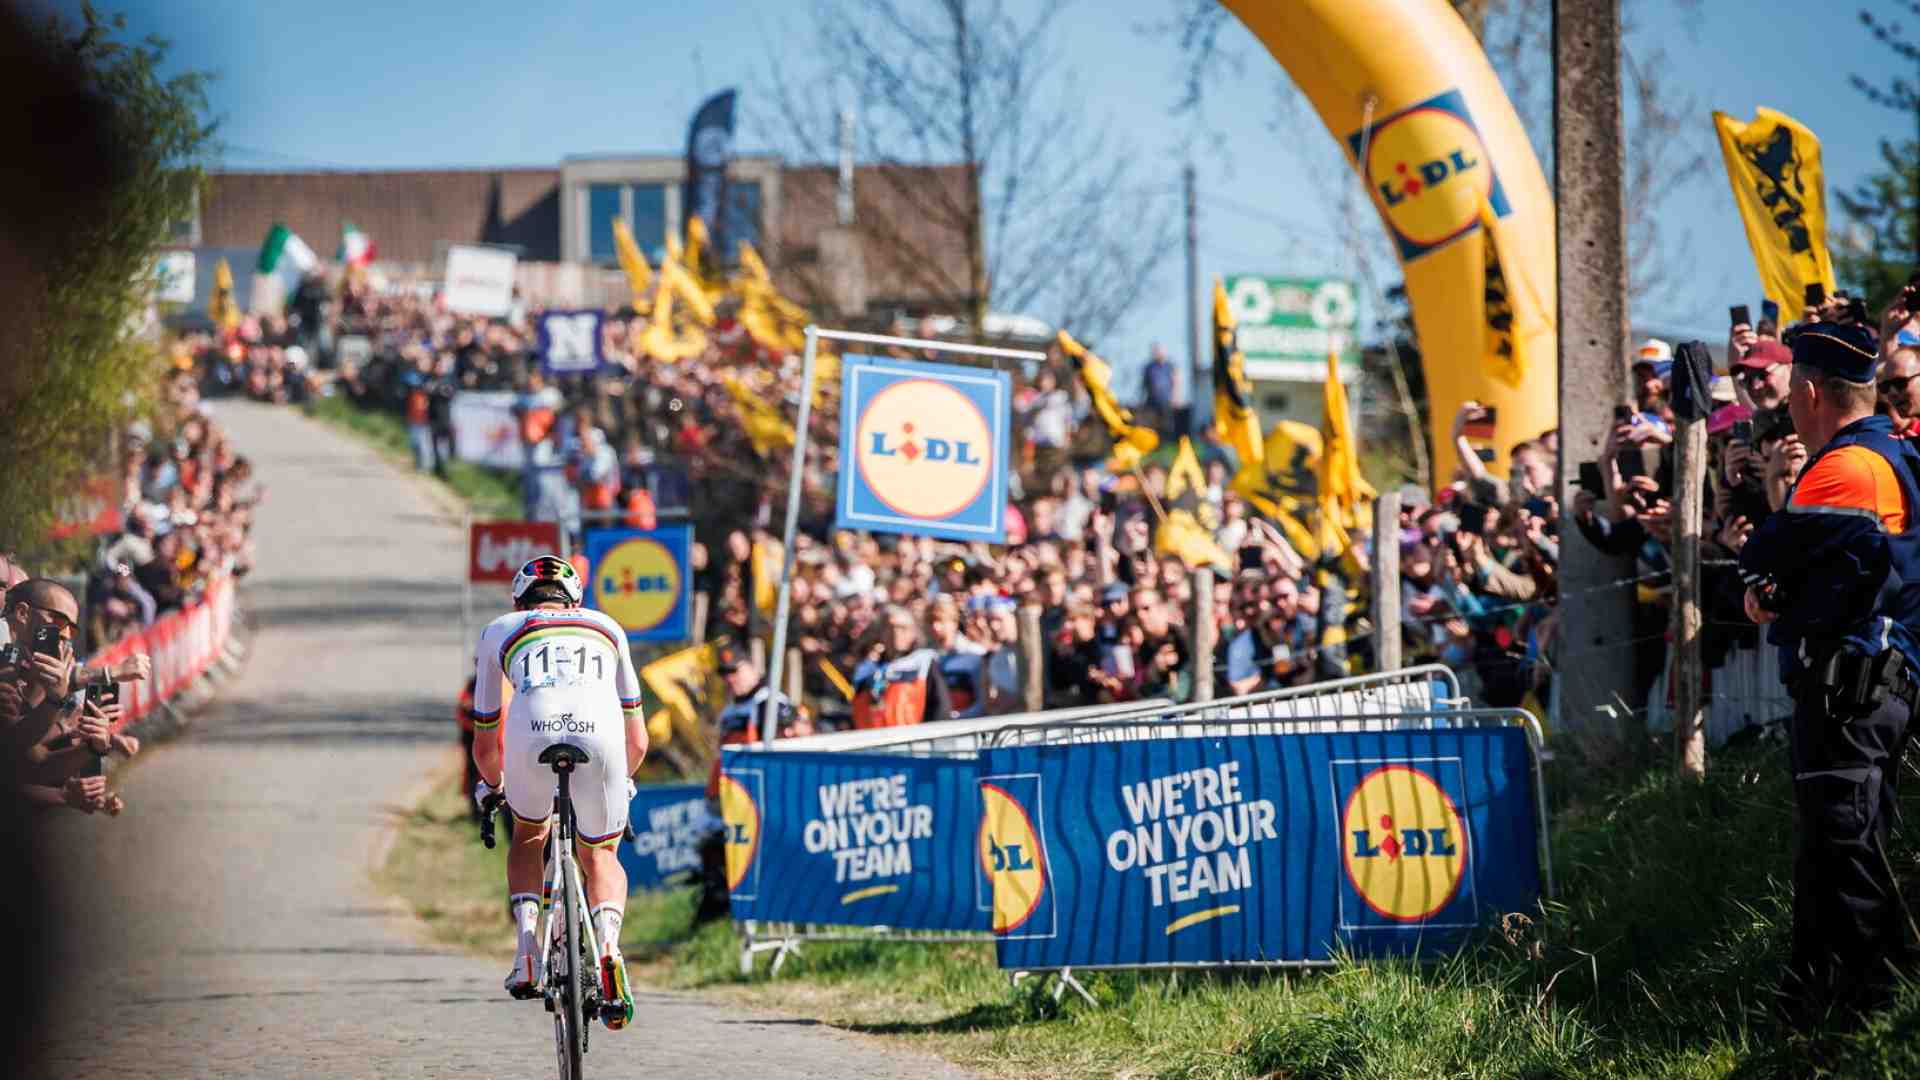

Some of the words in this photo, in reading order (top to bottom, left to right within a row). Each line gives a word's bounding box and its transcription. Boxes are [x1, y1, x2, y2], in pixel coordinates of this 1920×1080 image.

[530, 717, 595, 734] WHOOSH
[803, 817, 849, 854] ON
[848, 804, 934, 848] YOUR
[1106, 822, 1163, 872] ON
[1167, 799, 1278, 858] YOUR
[832, 842, 912, 883] TEAM
[1144, 847, 1252, 907] TEAM
